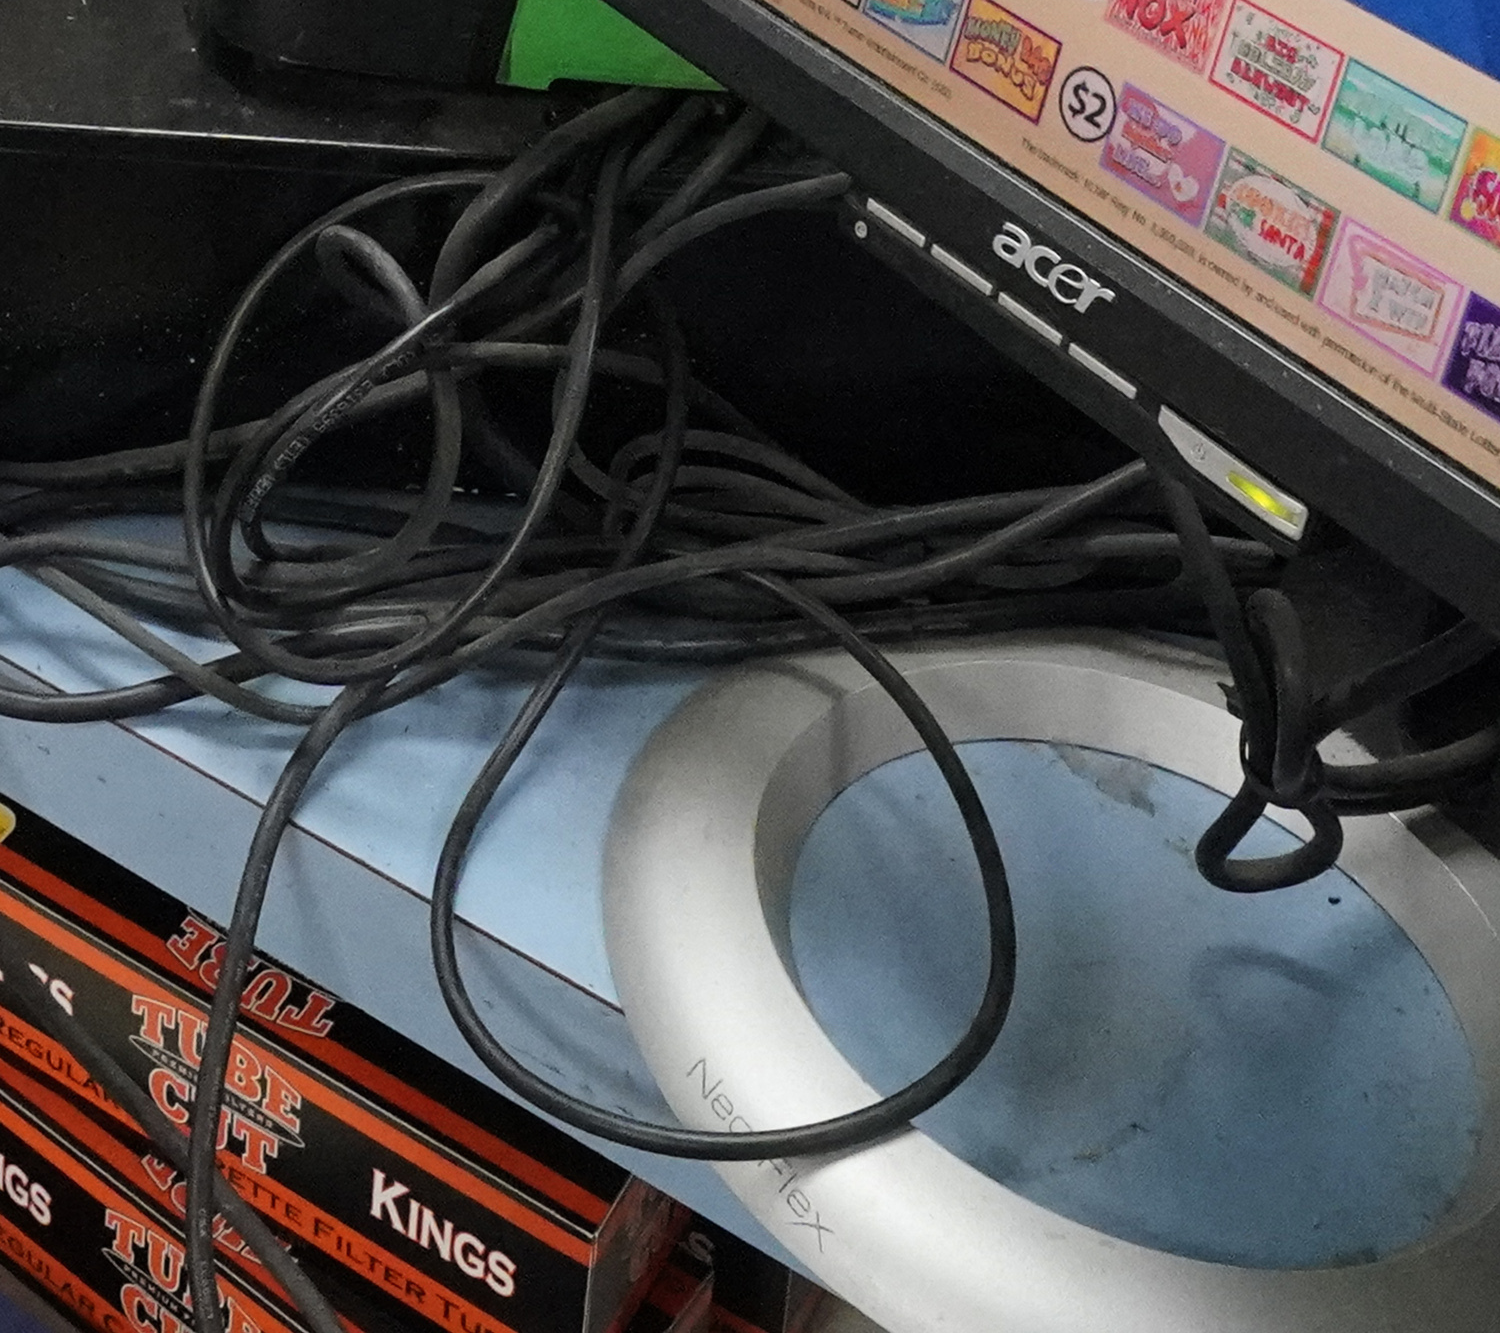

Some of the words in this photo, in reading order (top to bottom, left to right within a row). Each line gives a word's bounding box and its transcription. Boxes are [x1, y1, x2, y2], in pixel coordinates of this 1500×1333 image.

[966, 42, 1036, 102] BONUS
[1070, 82, 1107, 127] $2
[992, 222, 1116, 314] acer
[1259, 218, 1307, 260] SANTA
[132, 994, 301, 1133] TUBE
[313, 1216, 426, 1302] FILTER
[371, 1167, 517, 1299] KINGS
